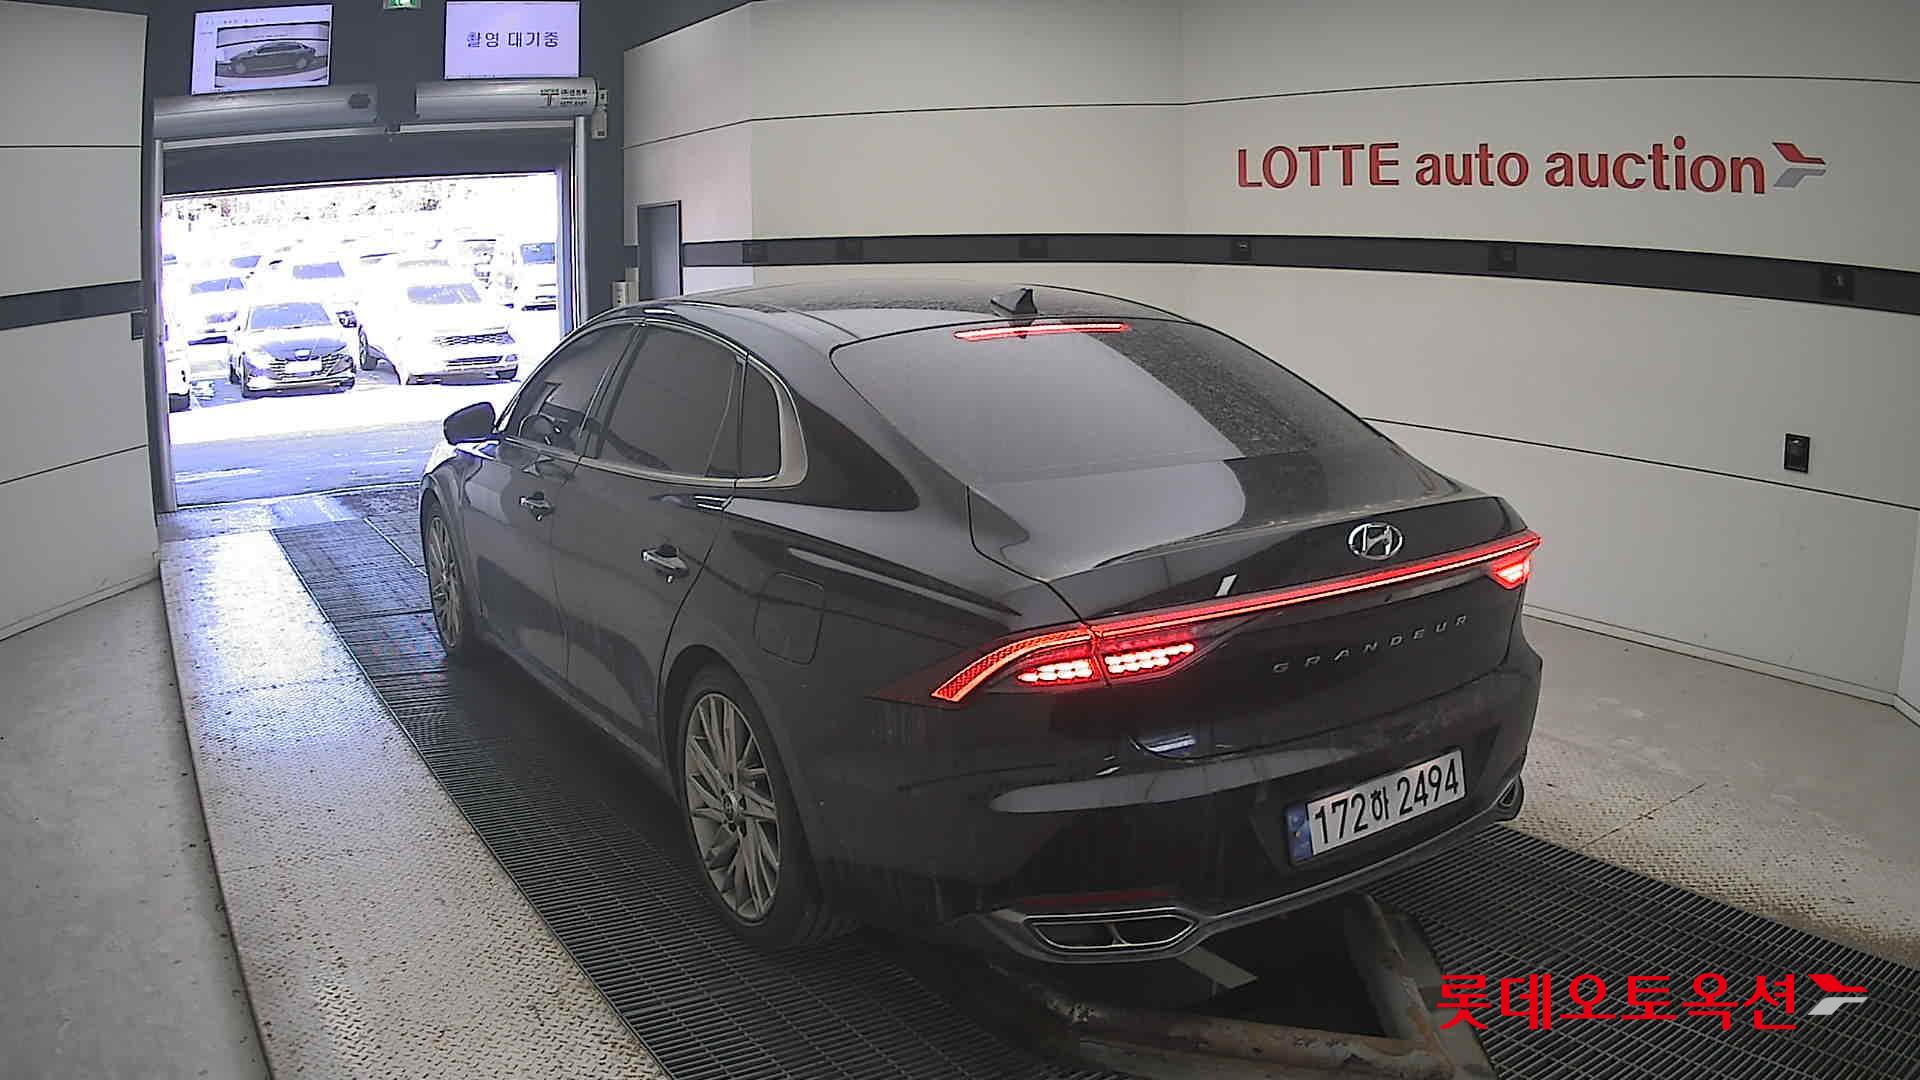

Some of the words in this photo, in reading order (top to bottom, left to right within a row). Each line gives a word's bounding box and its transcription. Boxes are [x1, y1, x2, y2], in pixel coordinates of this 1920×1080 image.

[508, 31, 559, 48] 대기중
[1238, 142, 1400, 188] LOTTE
[1415, 143, 1530, 188] auto
[1544, 135, 1767, 195] auction
[1272, 615, 1467, 673] GRANDEUR
[1314, 786, 1390, 845] 172하
[1396, 758, 1459, 817] 2494
